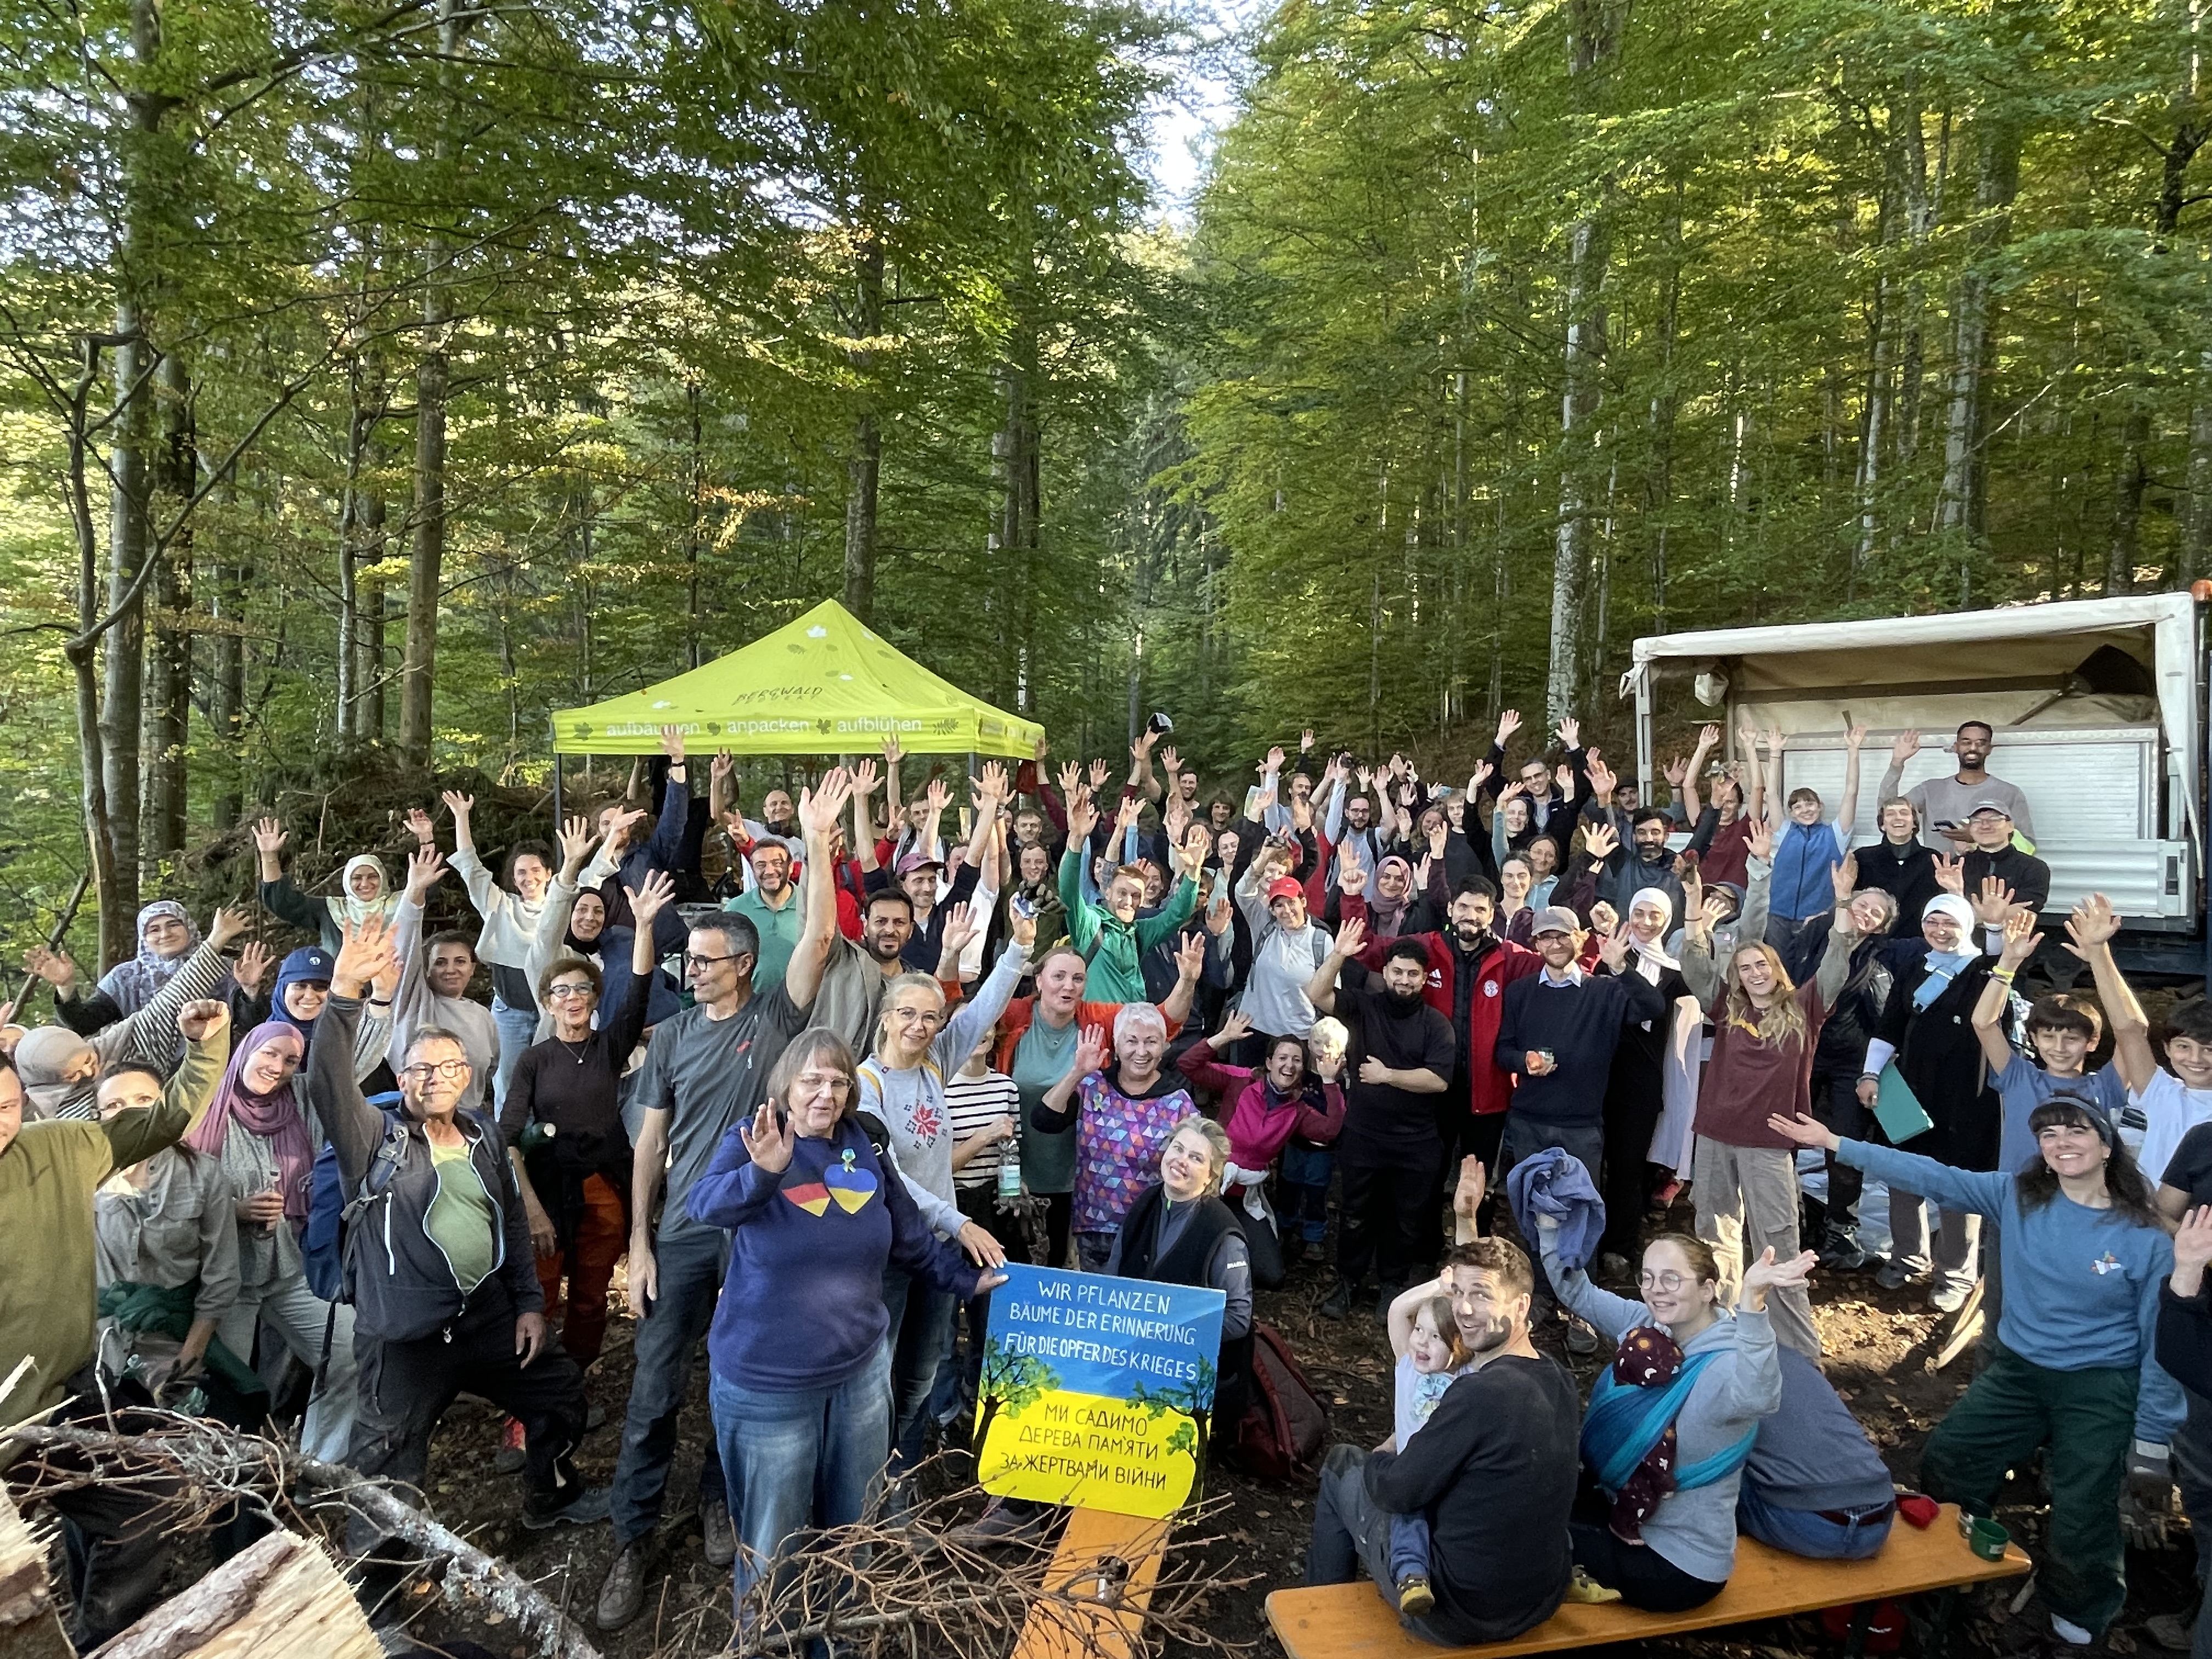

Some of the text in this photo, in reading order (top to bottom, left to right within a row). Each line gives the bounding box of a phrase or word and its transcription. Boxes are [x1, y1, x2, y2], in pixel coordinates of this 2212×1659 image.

[727, 718, 809, 735] anpacken
[837, 716, 922, 732] aufblühen
[1038, 1280, 1171, 1314] WIR PFLANZEN
[1009, 1300, 1198, 1346] BÄUME DER ERINNERUNG
[1005, 1331, 1197, 1380] FÜR DIE OPFER DES KRIEGES
[1044, 1403, 1148, 1436] МИ САДИМО
[1019, 1425, 1081, 1449] ДЕРЕВА
[1000, 1452, 1167, 1491] ЗА ЖЕРТВАМИ ВІЙНИ
